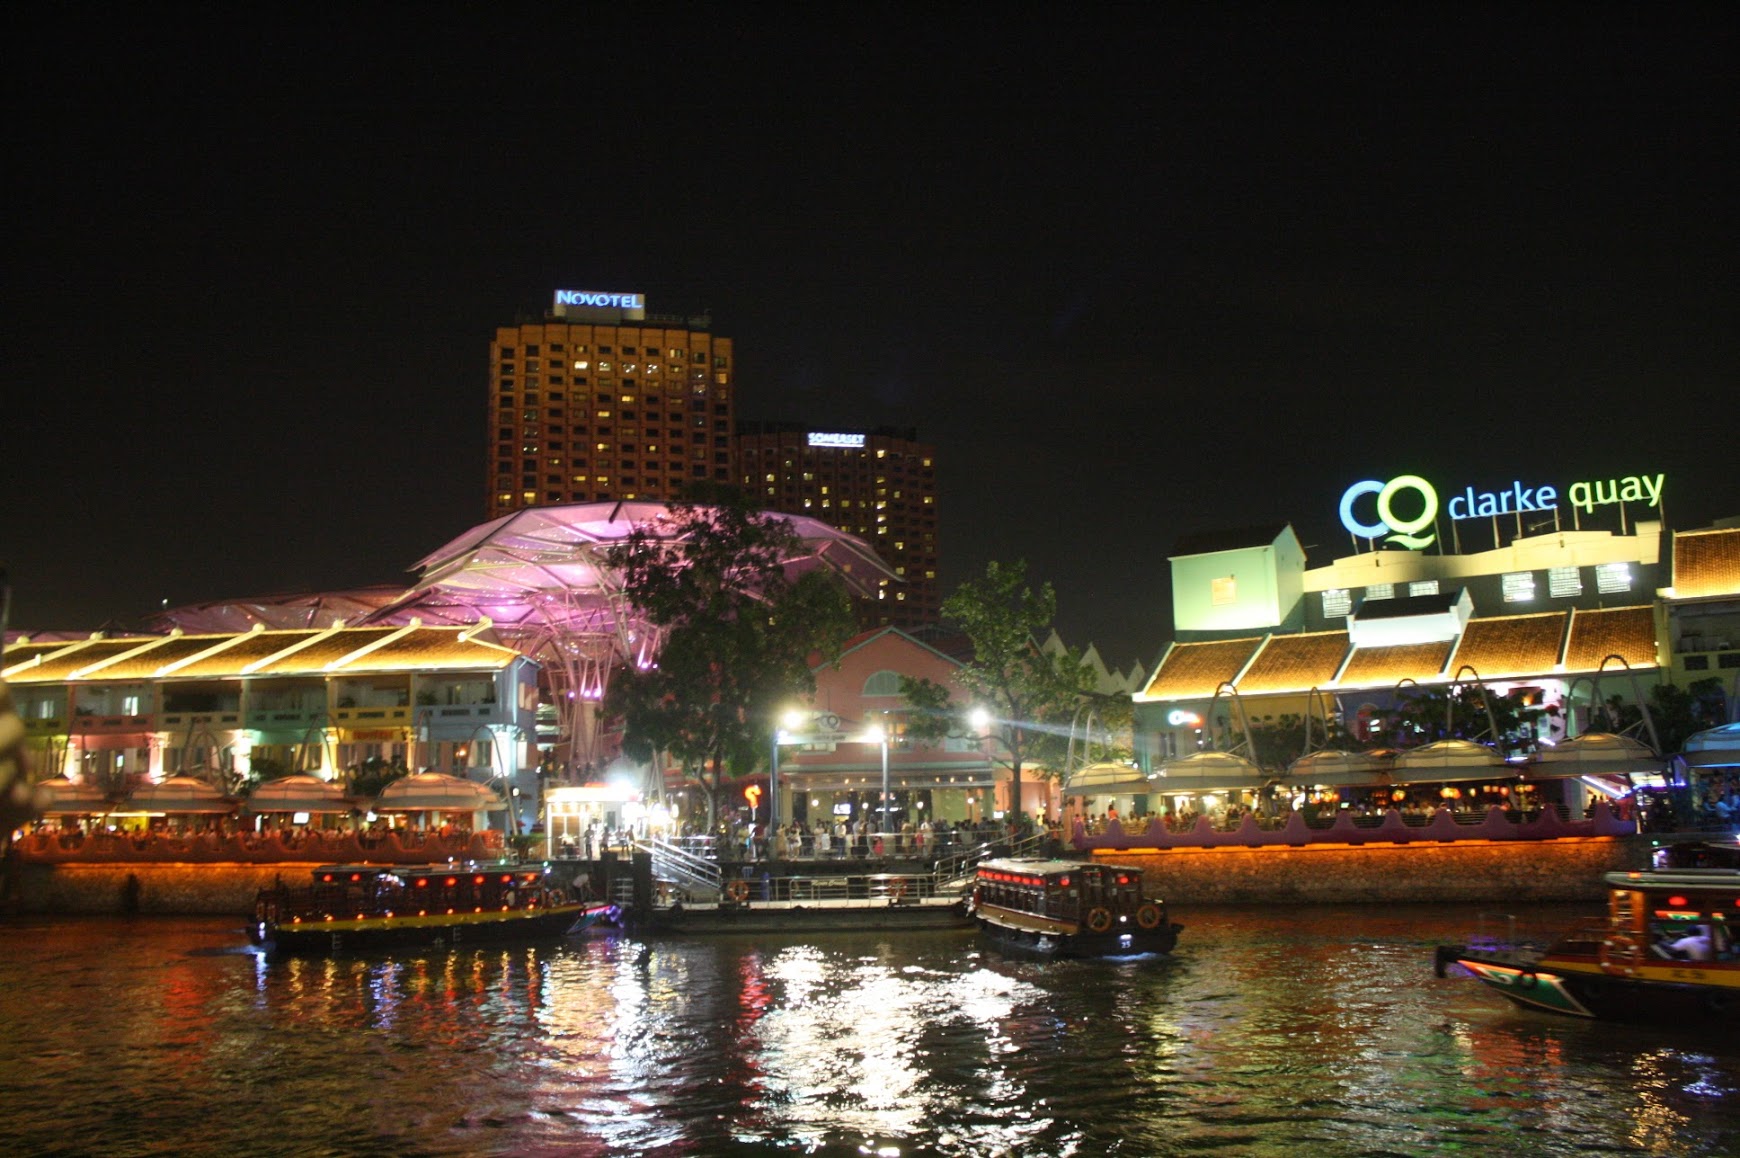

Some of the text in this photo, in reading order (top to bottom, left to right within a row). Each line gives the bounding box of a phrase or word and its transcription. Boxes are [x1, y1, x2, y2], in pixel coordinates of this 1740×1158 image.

[557, 289, 643, 308] NOVOTEL
[1448, 480, 1558, 520] clarke
[1568, 473, 1665, 514] quay
